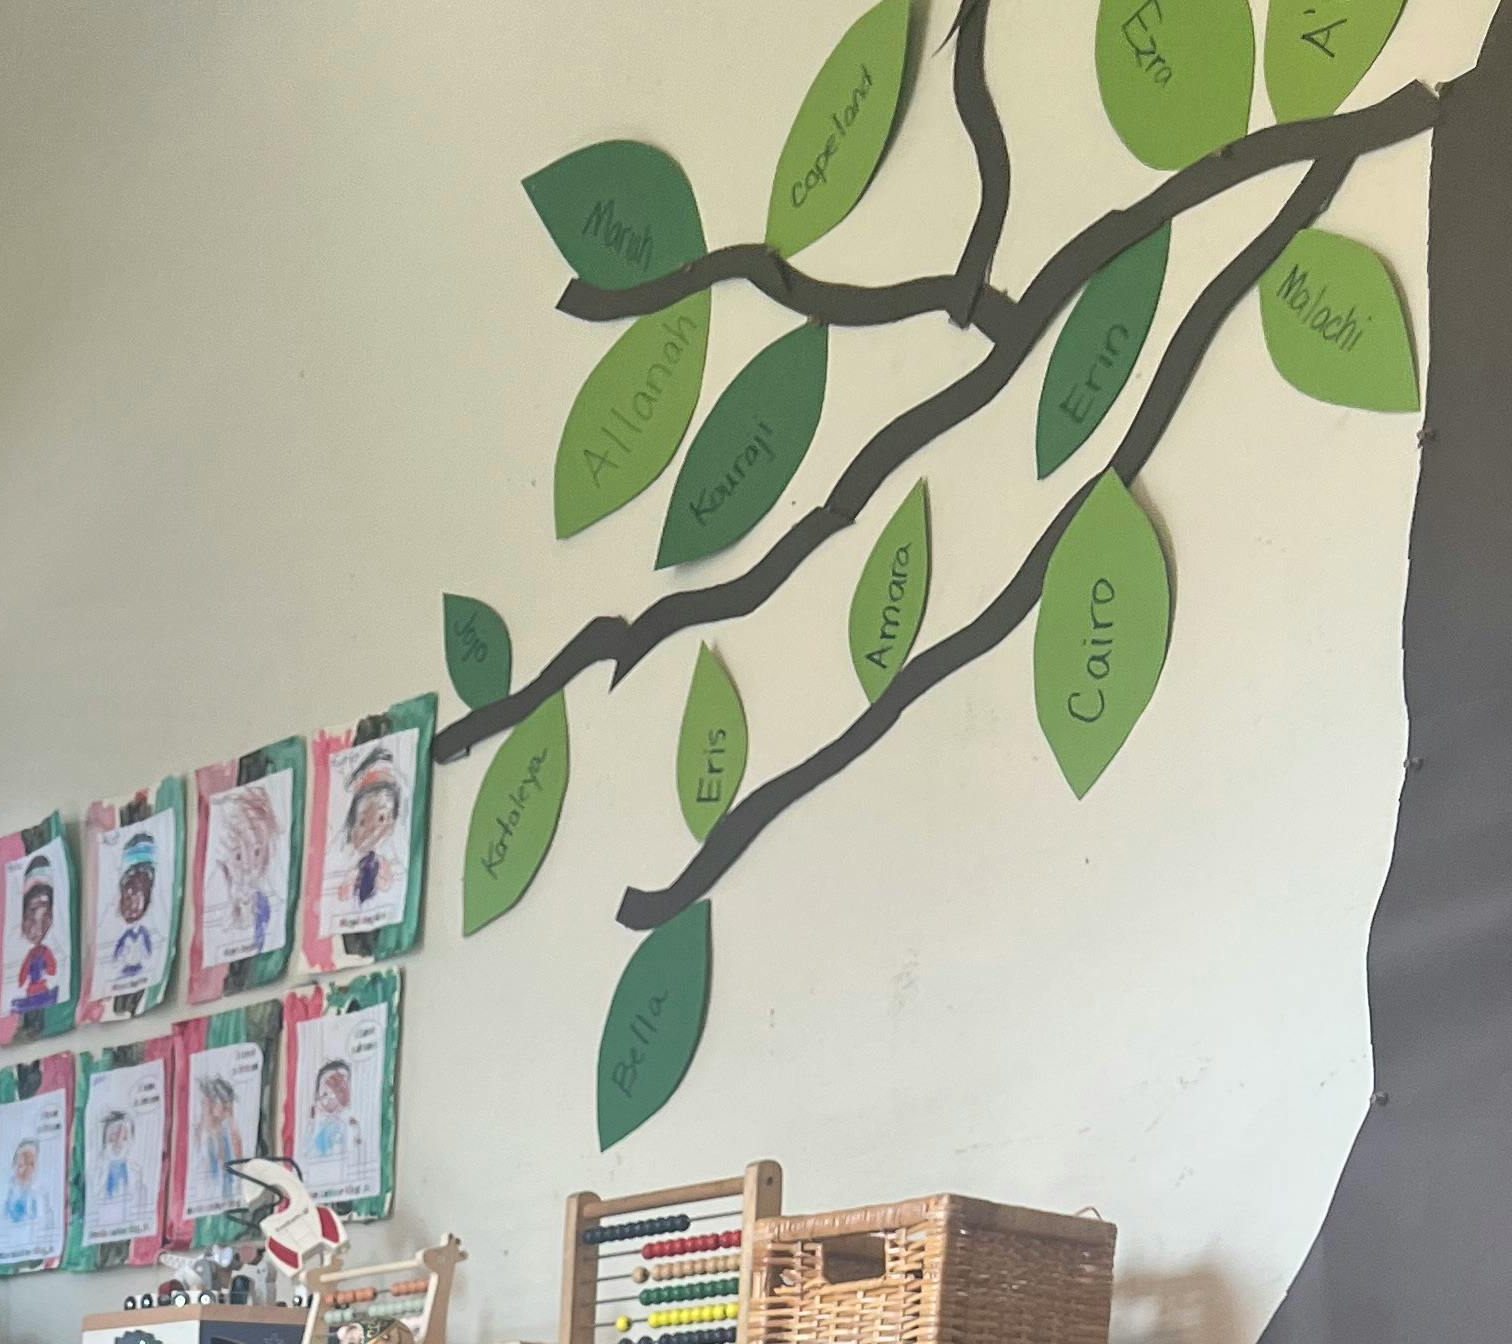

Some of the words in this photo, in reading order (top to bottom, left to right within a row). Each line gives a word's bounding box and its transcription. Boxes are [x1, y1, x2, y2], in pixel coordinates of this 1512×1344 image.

[1121, 0, 1173, 88] Ezra
[1275, 263, 1375, 352] Malachi
[583, 315, 697, 488] Allanah
[1058, 322, 1130, 424] Erin
[864, 541, 912, 670] Amara
[1067, 577, 1116, 723] Cairo
[695, 727, 727, 803] Eris
[611, 988, 669, 1099] Bella
